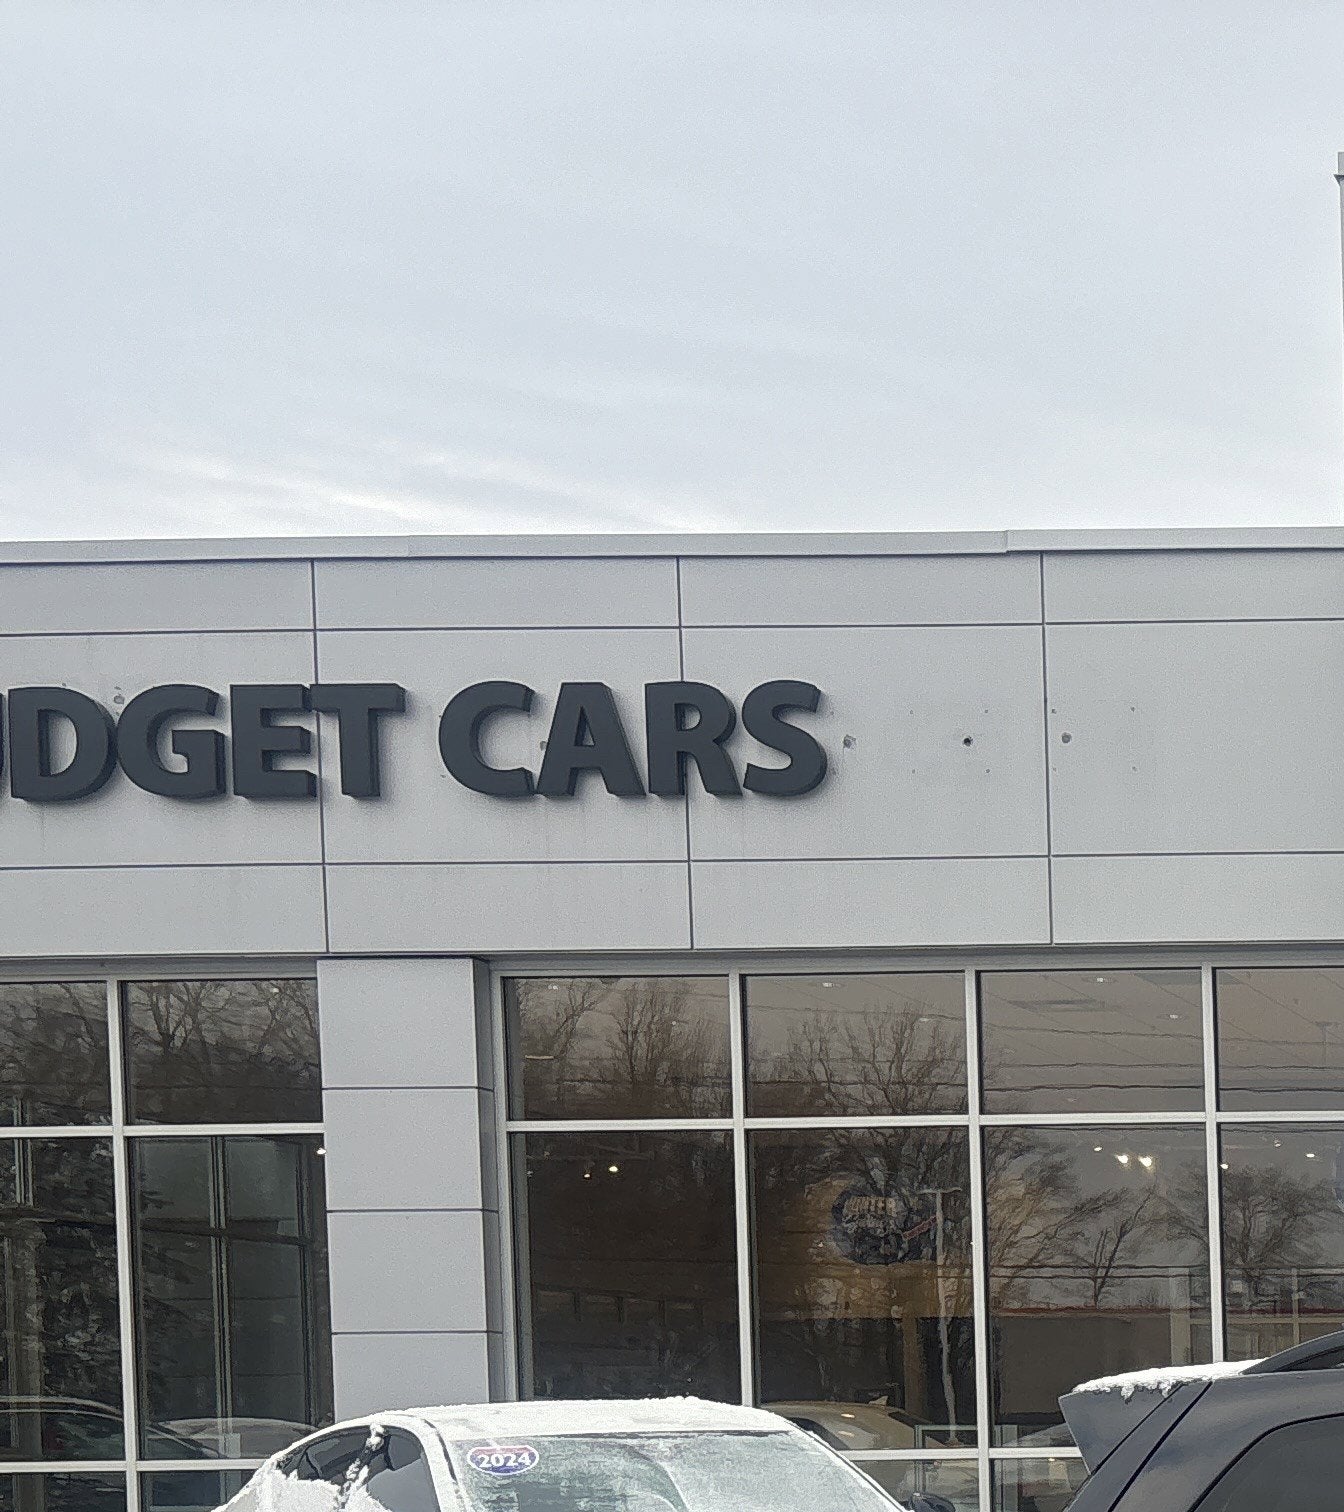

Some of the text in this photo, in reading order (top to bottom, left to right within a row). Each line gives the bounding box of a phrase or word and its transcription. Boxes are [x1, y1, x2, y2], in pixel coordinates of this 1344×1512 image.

[0, 680, 828, 799] DGET CARS
[477, 1452, 532, 1468] 2024
